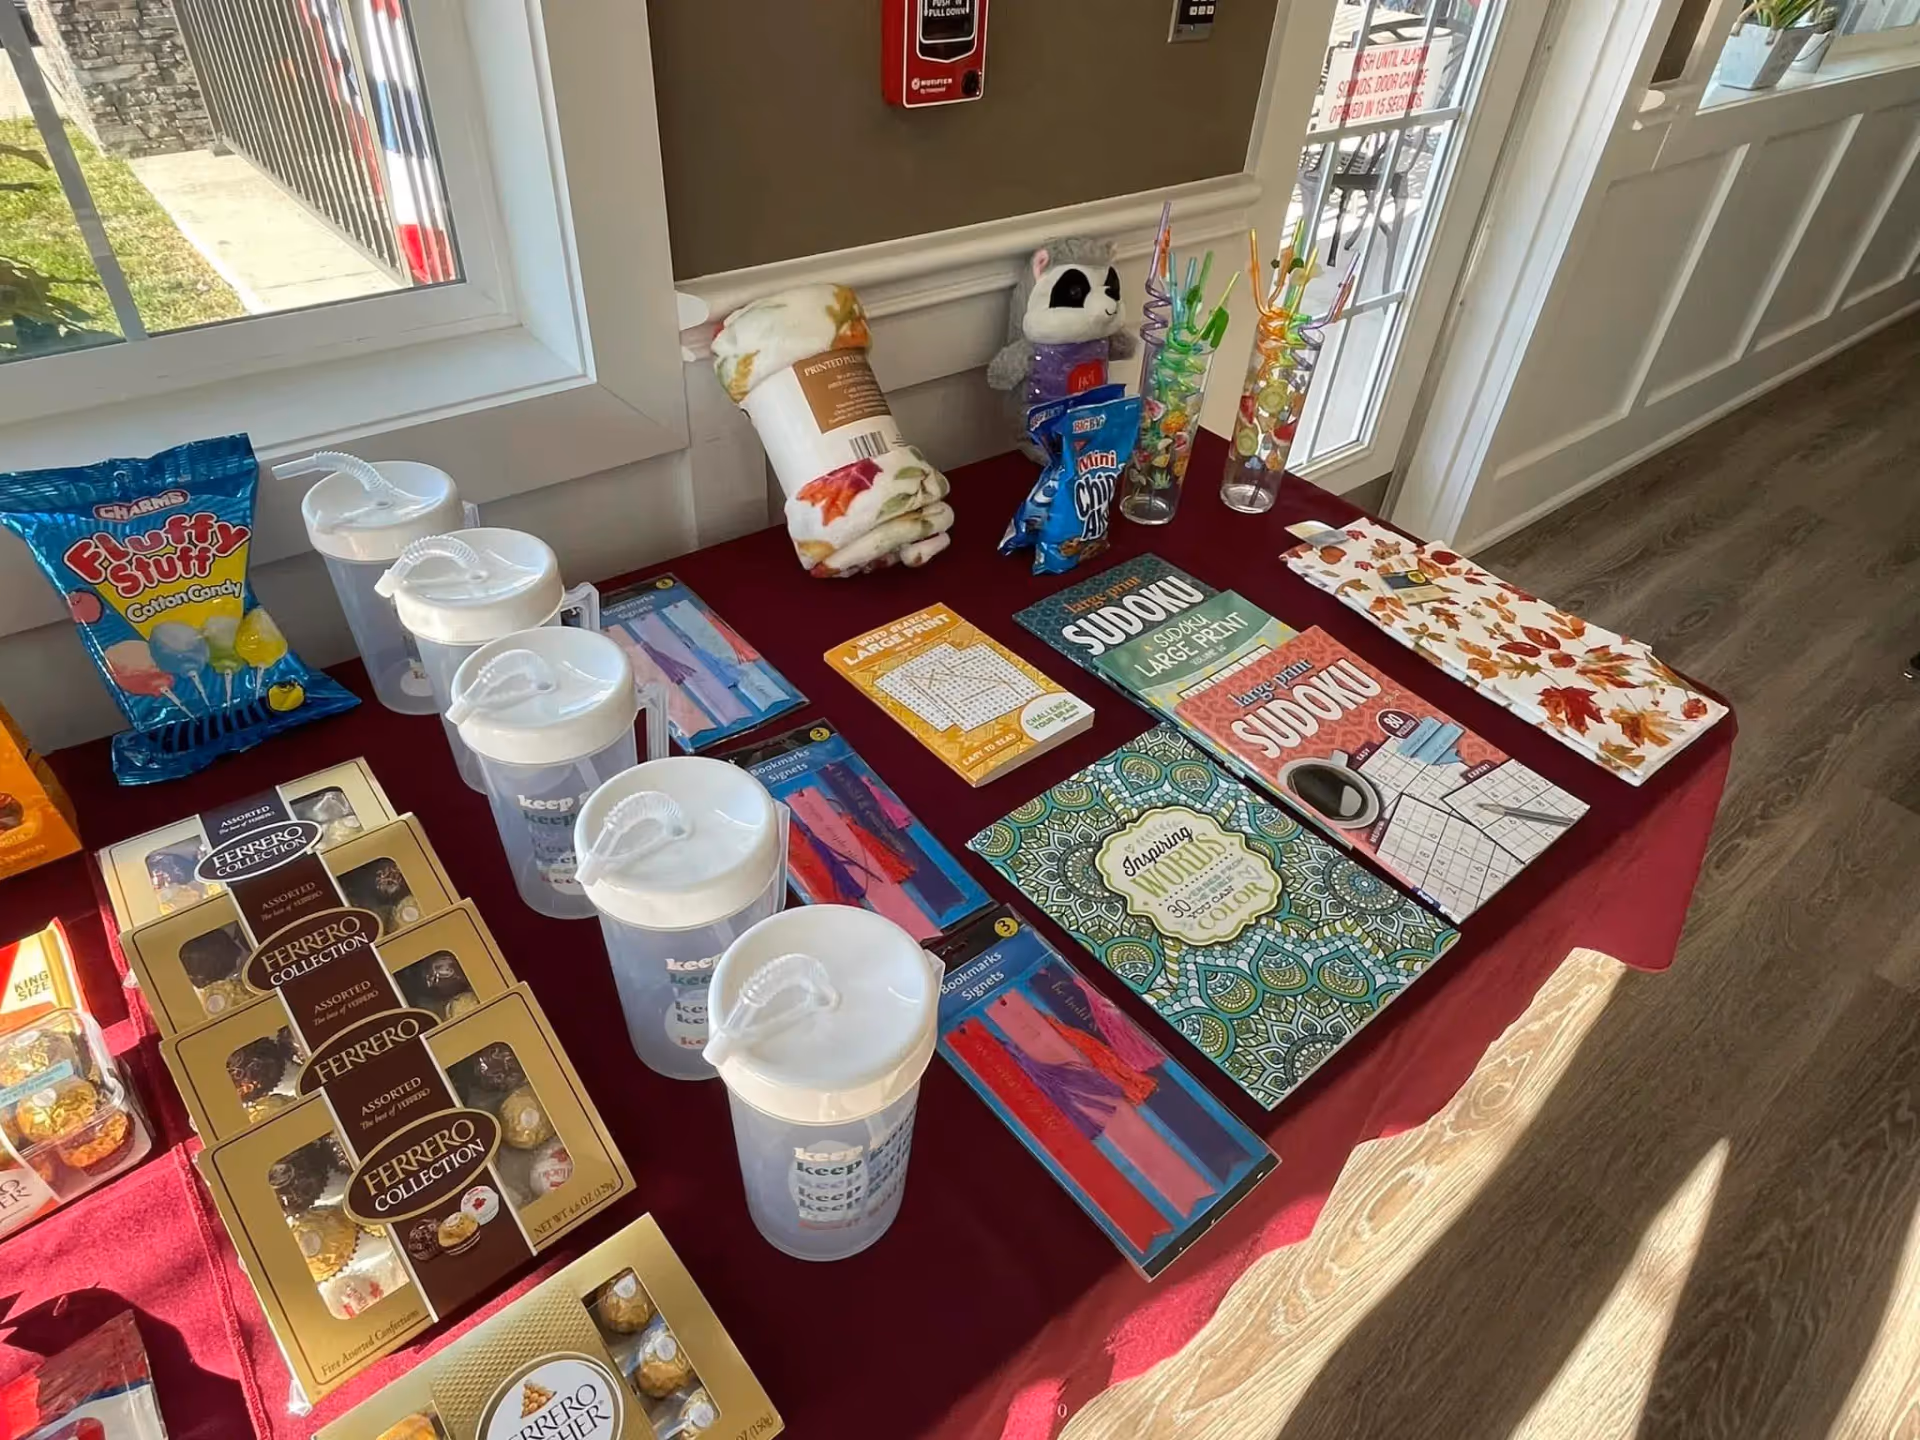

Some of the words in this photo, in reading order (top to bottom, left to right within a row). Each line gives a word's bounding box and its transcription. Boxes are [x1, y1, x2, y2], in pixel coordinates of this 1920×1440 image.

[928, 8, 946, 17] PULL
[946, 7, 966, 16] DOWN
[1376, 48, 1399, 70] UNTIL
[1374, 71, 1399, 93] DOOR
[1329, 100, 1364, 124] OPNED
[1363, 99, 1376, 117] IN
[1375, 96, 1387, 115] 15
[1386, 90, 1424, 114] SECODS
[804, 357, 842, 377] PRINTED
[1077, 450, 1117, 475] Mini
[99, 490, 187, 521] CHARMS
[1074, 470, 1119, 521] Chip
[64, 512, 251, 583] Fluffy
[107, 545, 213, 598] Stuff
[126, 594, 190, 624] Cotton
[186, 578, 243, 603] Candy
[602, 595, 656, 616] Bookmarks
[1063, 594, 1107, 615] large
[1106, 575, 1142, 599] print
[857, 630, 888, 647] WORD
[889, 613, 931, 633] SEARCH
[1062, 575, 1204, 656] SUDOKU
[1153, 613, 1212, 648] SUDOKU
[843, 633, 905, 666] LARGE
[902, 613, 950, 638] PRINT
[1134, 641, 1200, 678] LARGE
[1191, 611, 1249, 649] PRINT
[1227, 680, 1276, 707] large
[1274, 658, 1314, 690] print
[1026, 699, 1071, 727] CHALLENGE
[1032, 716, 1054, 730] YOUR
[1052, 703, 1079, 720] BRAIN
[1231, 658, 1382, 759] SUDOKU
[1383, 713, 1404, 729] 80
[751, 749, 810, 777] Bookmarks
[962, 749, 985, 766] EASY
[984, 743, 996, 753] TO
[995, 732, 1017, 747] READ
[769, 762, 809, 784] Signets
[221, 805, 270, 828] ASSORTED
[517, 794, 574, 812] keep
[522, 810, 577, 827] keep
[212, 826, 303, 868] FERRERO
[216, 836, 307, 877] COLLECTION
[1122, 826, 1194, 877] Inspiring
[1129, 832, 1227, 899] WORDS
[262, 881, 316, 910] ASSORTED
[1167, 899, 1192, 919] 30
[1187, 903, 1212, 920] YOU
[1211, 884, 1236, 905] CAN
[1198, 880, 1271, 930] COLOR
[999, 919, 1011, 932] 3
[261, 916, 360, 974] FERRERO
[270, 931, 369, 986] COLLECTION
[14, 970, 49, 993] KING
[669, 973, 712, 986] kee
[940, 951, 1003, 995] Bookmarks
[962, 971, 1005, 1002] Signets
[17, 981, 51, 1002] SIZE
[314, 980, 371, 1015] ASSORTED
[675, 1001, 708, 1013] ke
[676, 1013, 708, 1025] ke
[313, 1018, 420, 1084] FERRERO
[359, 1120, 374, 1130] The
[374, 1111, 388, 1124] best
[388, 1104, 397, 1116] of
[397, 1087, 431, 1111] FERRERO
[360, 1076, 422, 1117] ASSORTED
[362, 1119, 475, 1197] FERRERO
[794, 1144, 863, 1162] keep
[796, 1160, 862, 1176] keep
[374, 1138, 486, 1212] COLLECTION
[798, 1185, 862, 1202] keep
[799, 1197, 862, 1212] keep
[533, 1219, 552, 1236] NET
[551, 1208, 569, 1222] WT
[580, 1192, 595, 1206] OZ
[320, 1361, 341, 1377] Fine
[341, 1335, 375, 1362] Assorted
[508, 1383, 597, 1440] ERRERO
